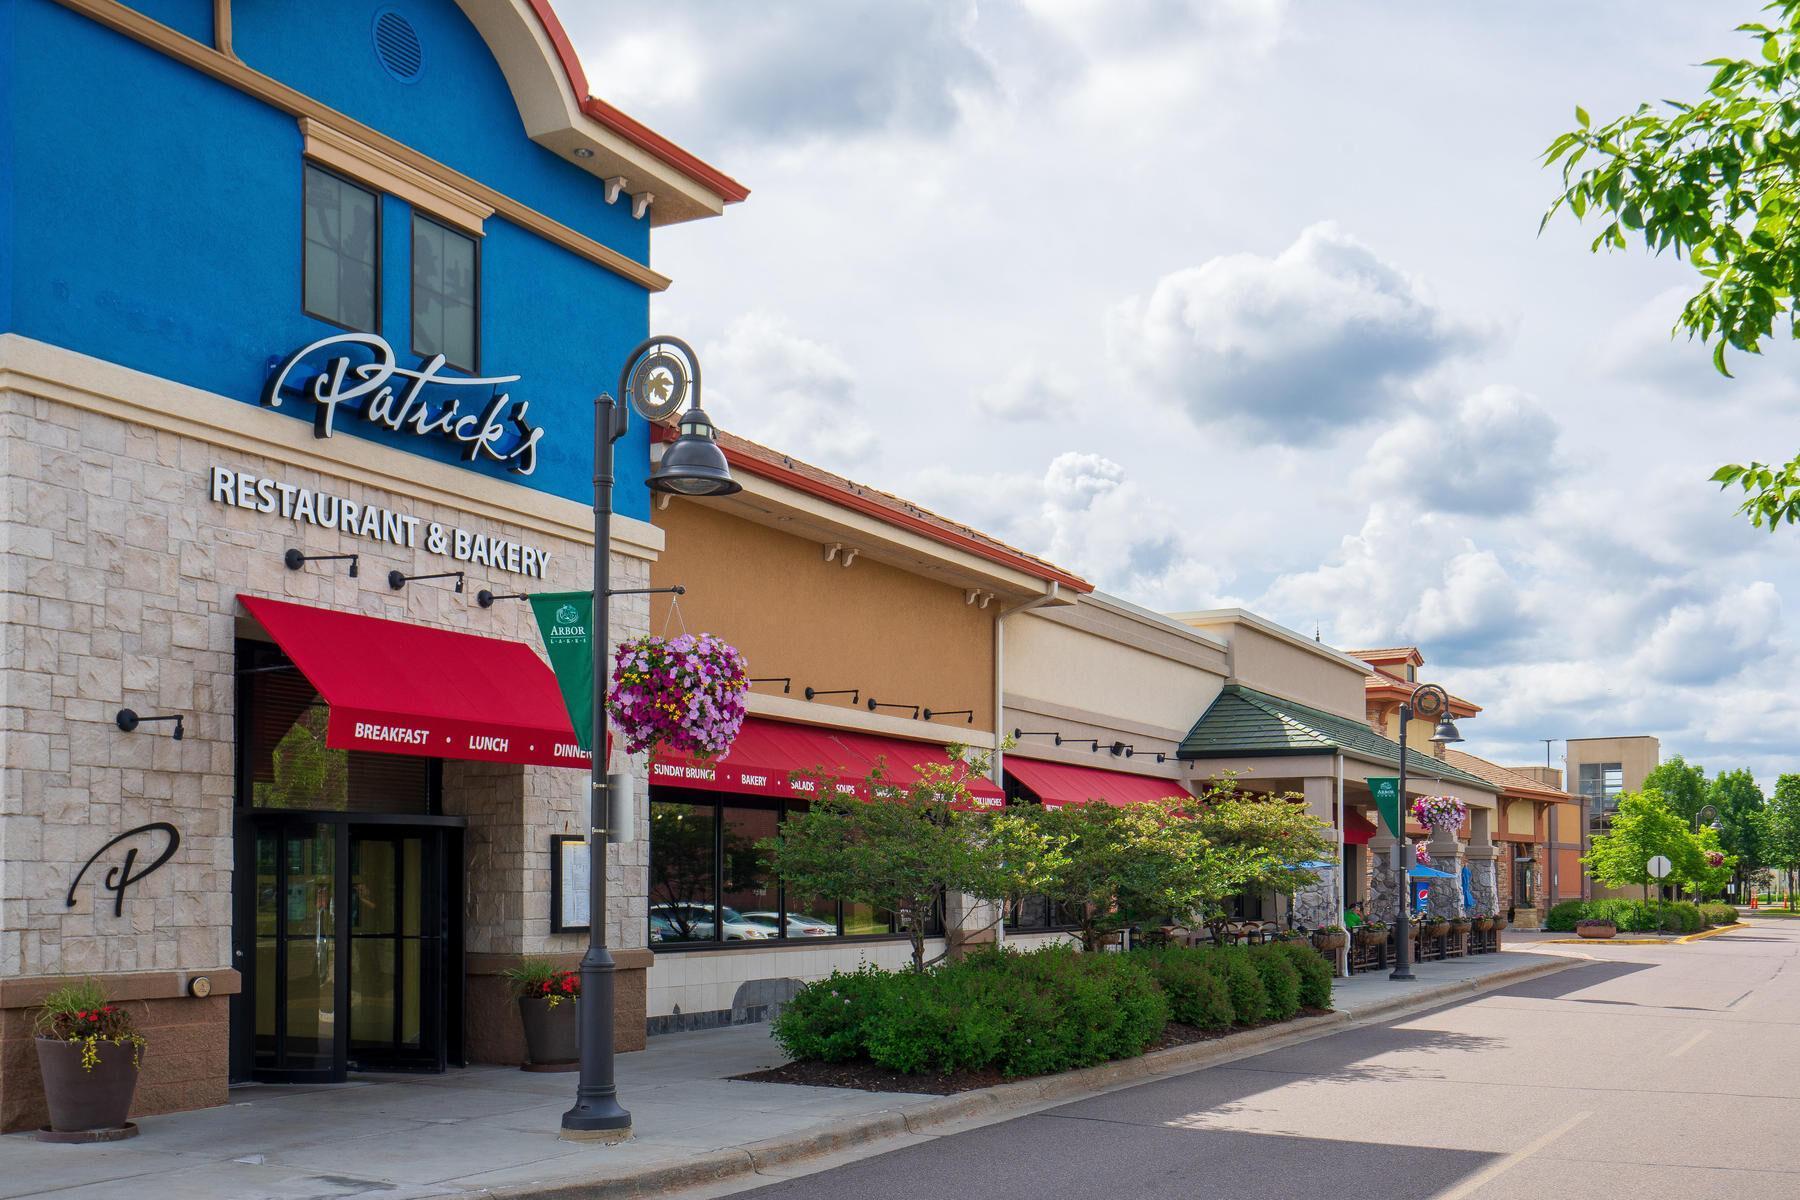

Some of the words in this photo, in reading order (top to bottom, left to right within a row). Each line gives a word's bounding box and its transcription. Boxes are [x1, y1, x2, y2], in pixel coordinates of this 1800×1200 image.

[270, 333, 545, 475] Patrick's
[211, 466, 420, 547] RESTAURANT
[426, 522, 448, 556] &
[453, 529, 551, 579] BAKERY
[550, 625, 586, 636] ARBOR
[354, 722, 430, 745] BREAKFAST
[469, 735, 509, 753] LUNCH
[653, 763, 685, 777] SUNDAY
[741, 774, 767, 787] BAKERY
[790, 780, 815, 792] SALADS
